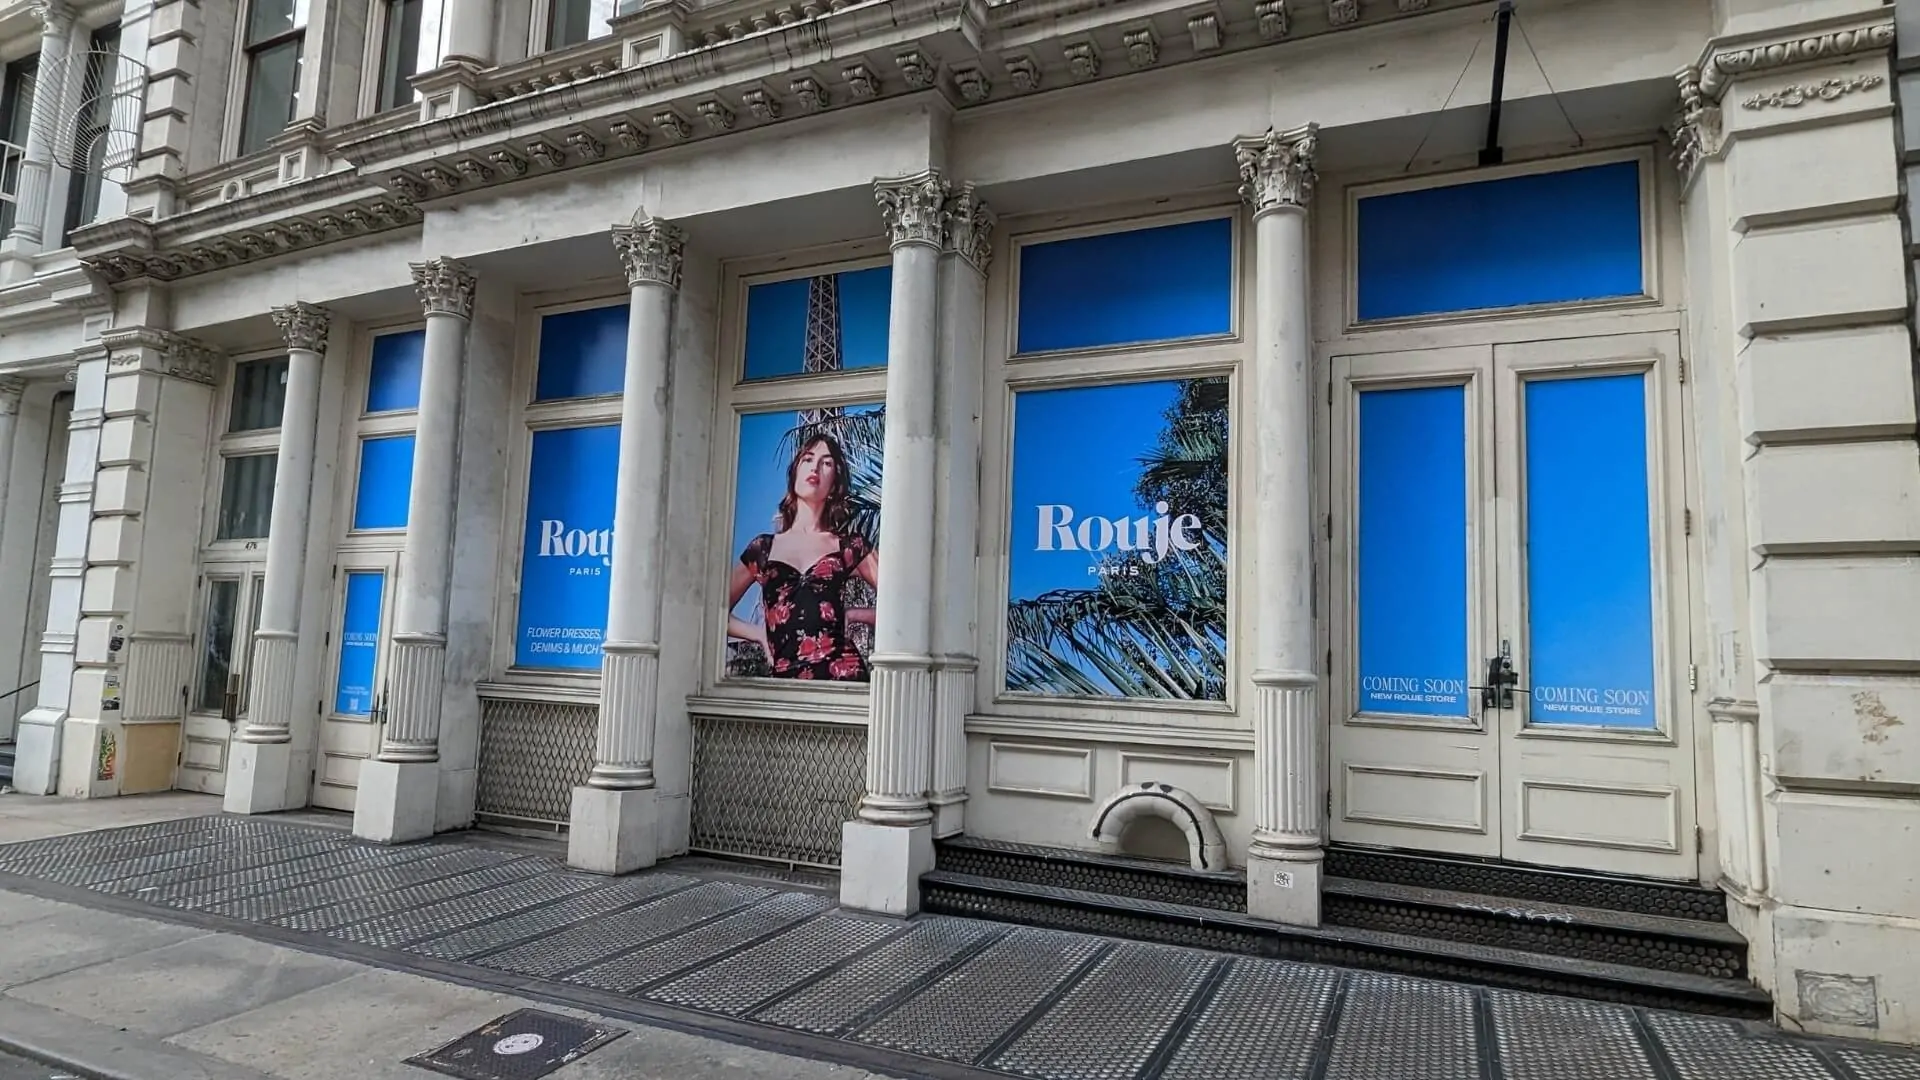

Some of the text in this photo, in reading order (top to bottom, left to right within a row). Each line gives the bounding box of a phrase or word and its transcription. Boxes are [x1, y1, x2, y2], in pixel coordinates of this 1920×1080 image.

[1034, 501, 1202, 564] Rouje
[538, 519, 612, 567] Rou
[569, 567, 602, 576] PARIS
[1088, 566, 1140, 576] PARIS
[527, 627, 561, 638] FLOWER
[530, 642, 563, 653] DENIMS
[564, 643, 570, 654] &
[571, 643, 599, 655] MUCH
[1363, 676, 1465, 694] COMING SOON
[1425, 695, 1457, 703] STORE
[1534, 686, 1651, 706] COMING SOON
[1543, 703, 1568, 712] NEW
[1606, 706, 1641, 715] STORE
